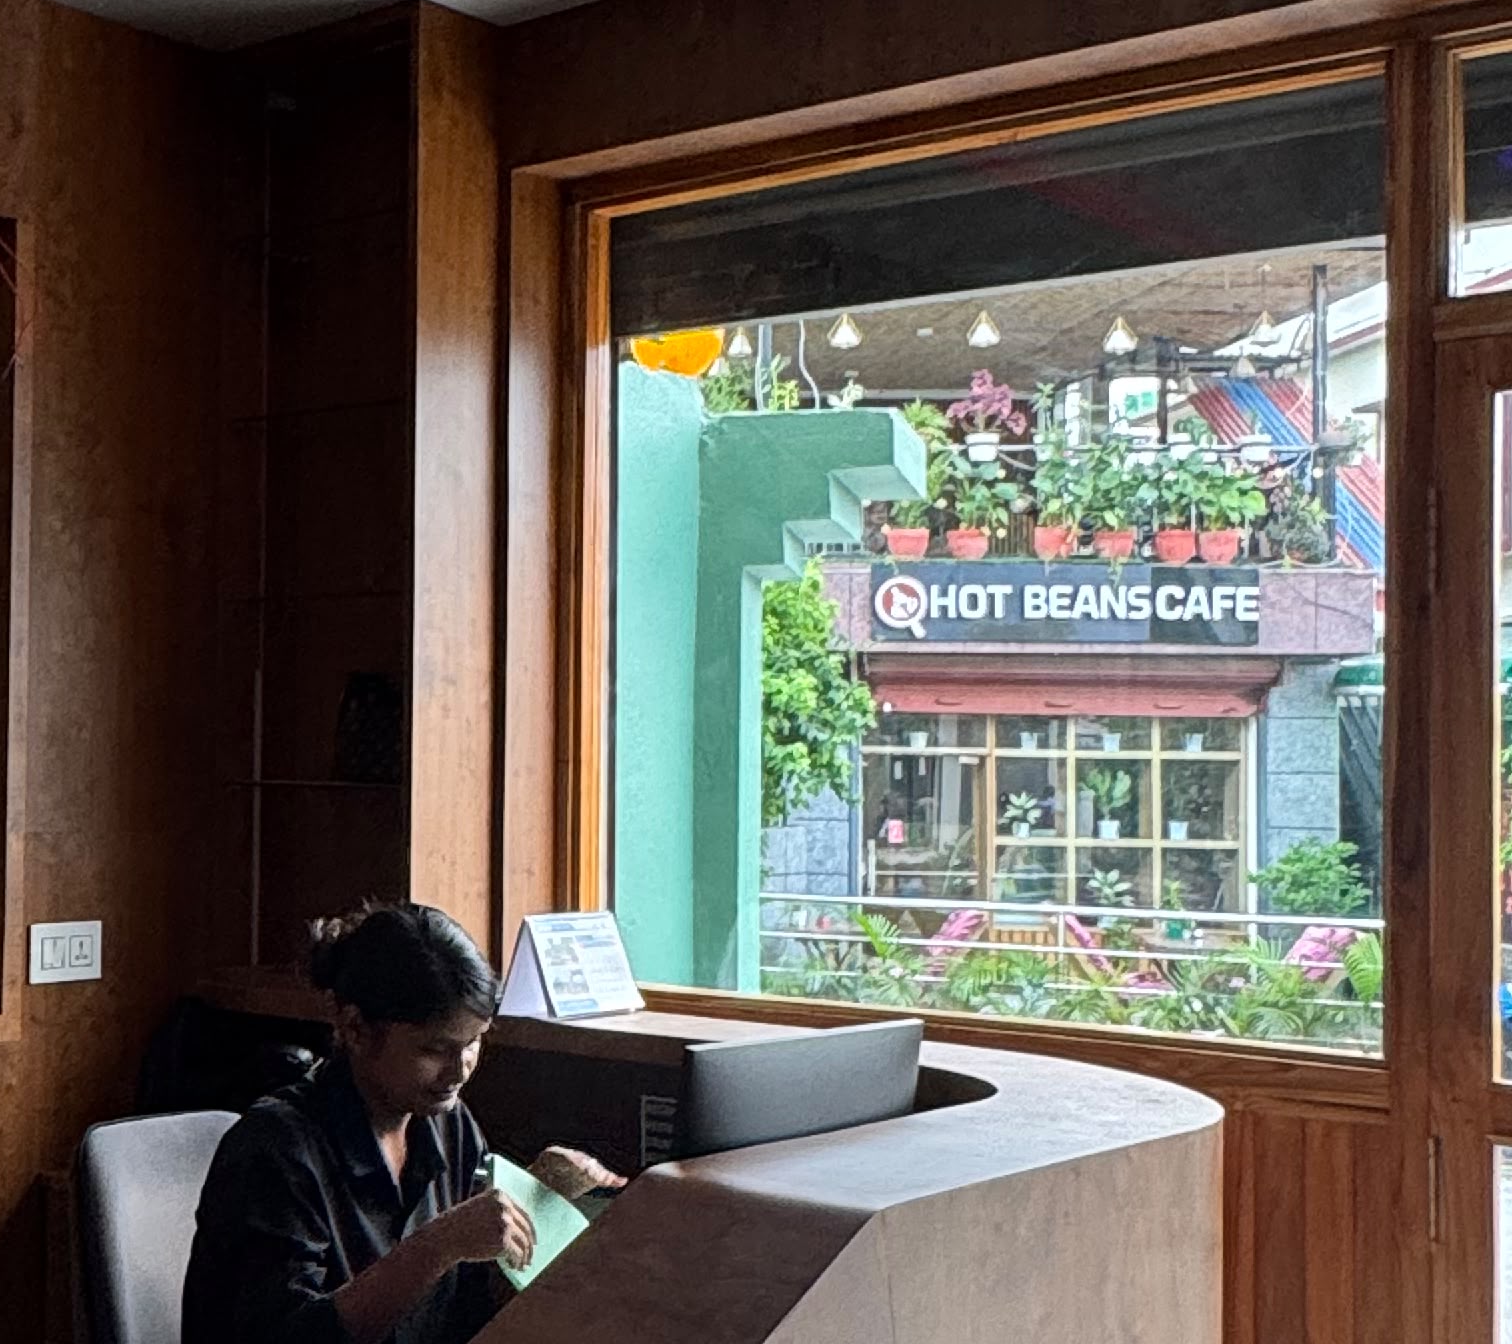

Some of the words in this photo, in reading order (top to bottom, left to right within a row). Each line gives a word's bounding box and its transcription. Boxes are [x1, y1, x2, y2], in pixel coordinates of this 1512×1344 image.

[930, 583, 1013, 620] HOT
[1023, 583, 1151, 621] BEANS
[1155, 585, 1260, 622] CAFE
